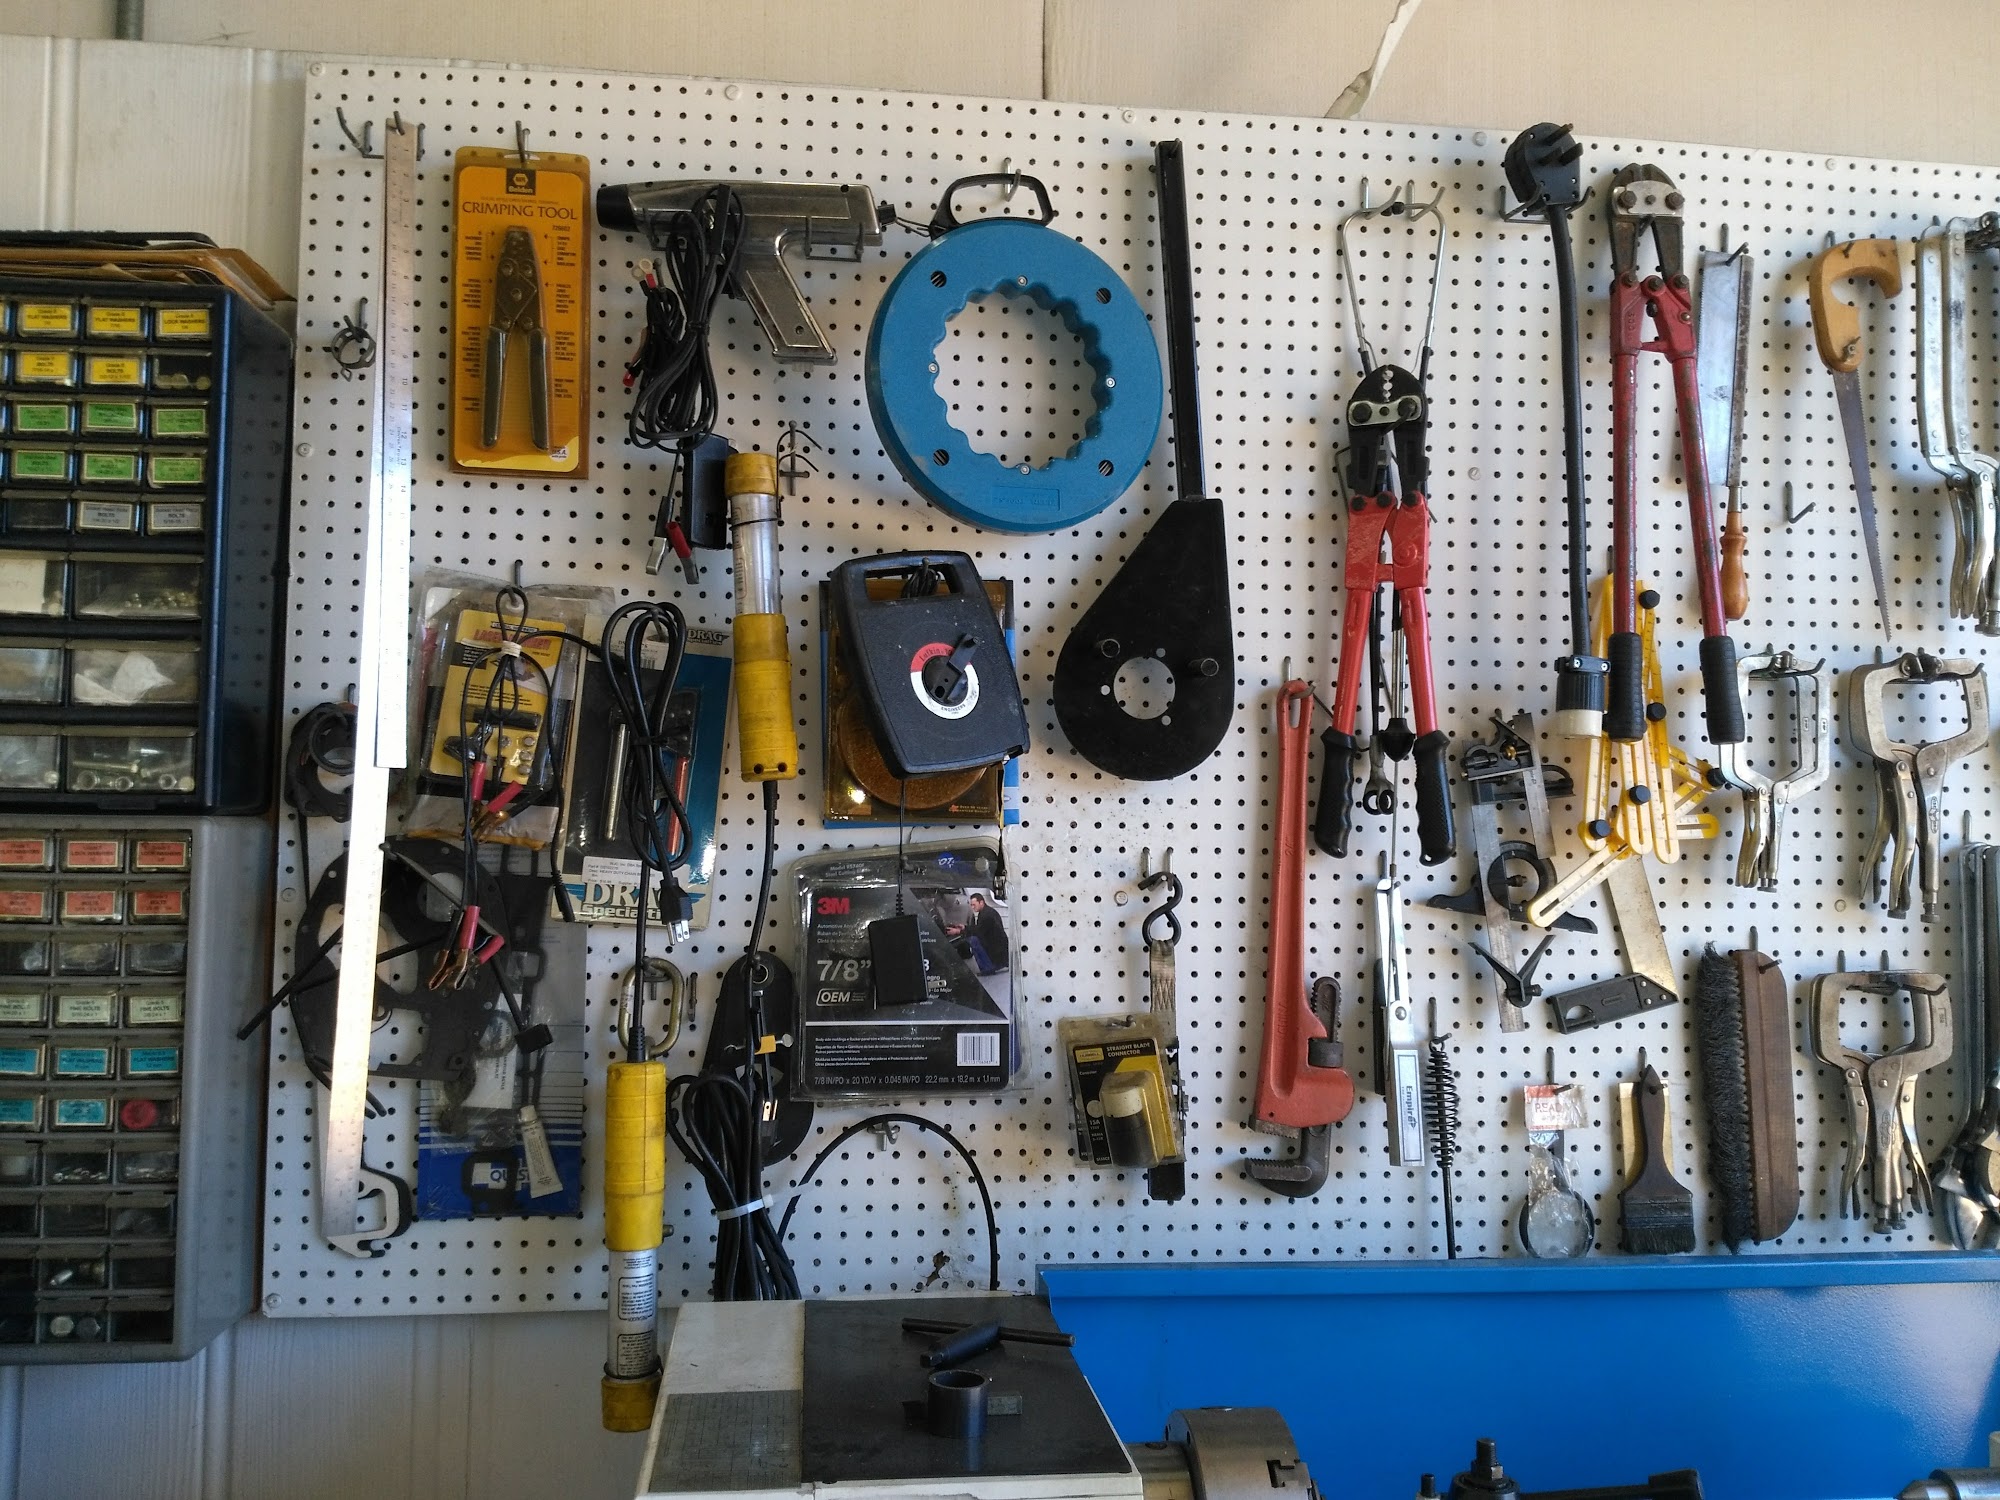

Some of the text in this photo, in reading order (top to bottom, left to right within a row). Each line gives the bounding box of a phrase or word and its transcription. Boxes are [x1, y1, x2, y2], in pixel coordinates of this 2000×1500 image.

[462, 202, 577, 221] CRIMPING TOOL
[687, 629, 722, 642] DRAG
[919, 648, 940, 662] Lufkin
[583, 882, 662, 910] DRA
[582, 904, 661, 921] Speciati
[817, 897, 850, 915] 3M
[816, 959, 872, 982] 7/8"
[821, 991, 851, 1003] OEM
[1106, 1044, 1133, 1052] STRAIGHT
[1107, 1049, 1141, 1058] CONNECTOR
[814, 1076, 825, 1085] 7/8
[825, 1076, 844, 1085] IN/PO
[852, 1076, 860, 1085] 20
[1405, 1085, 1415, 1123] Empire
